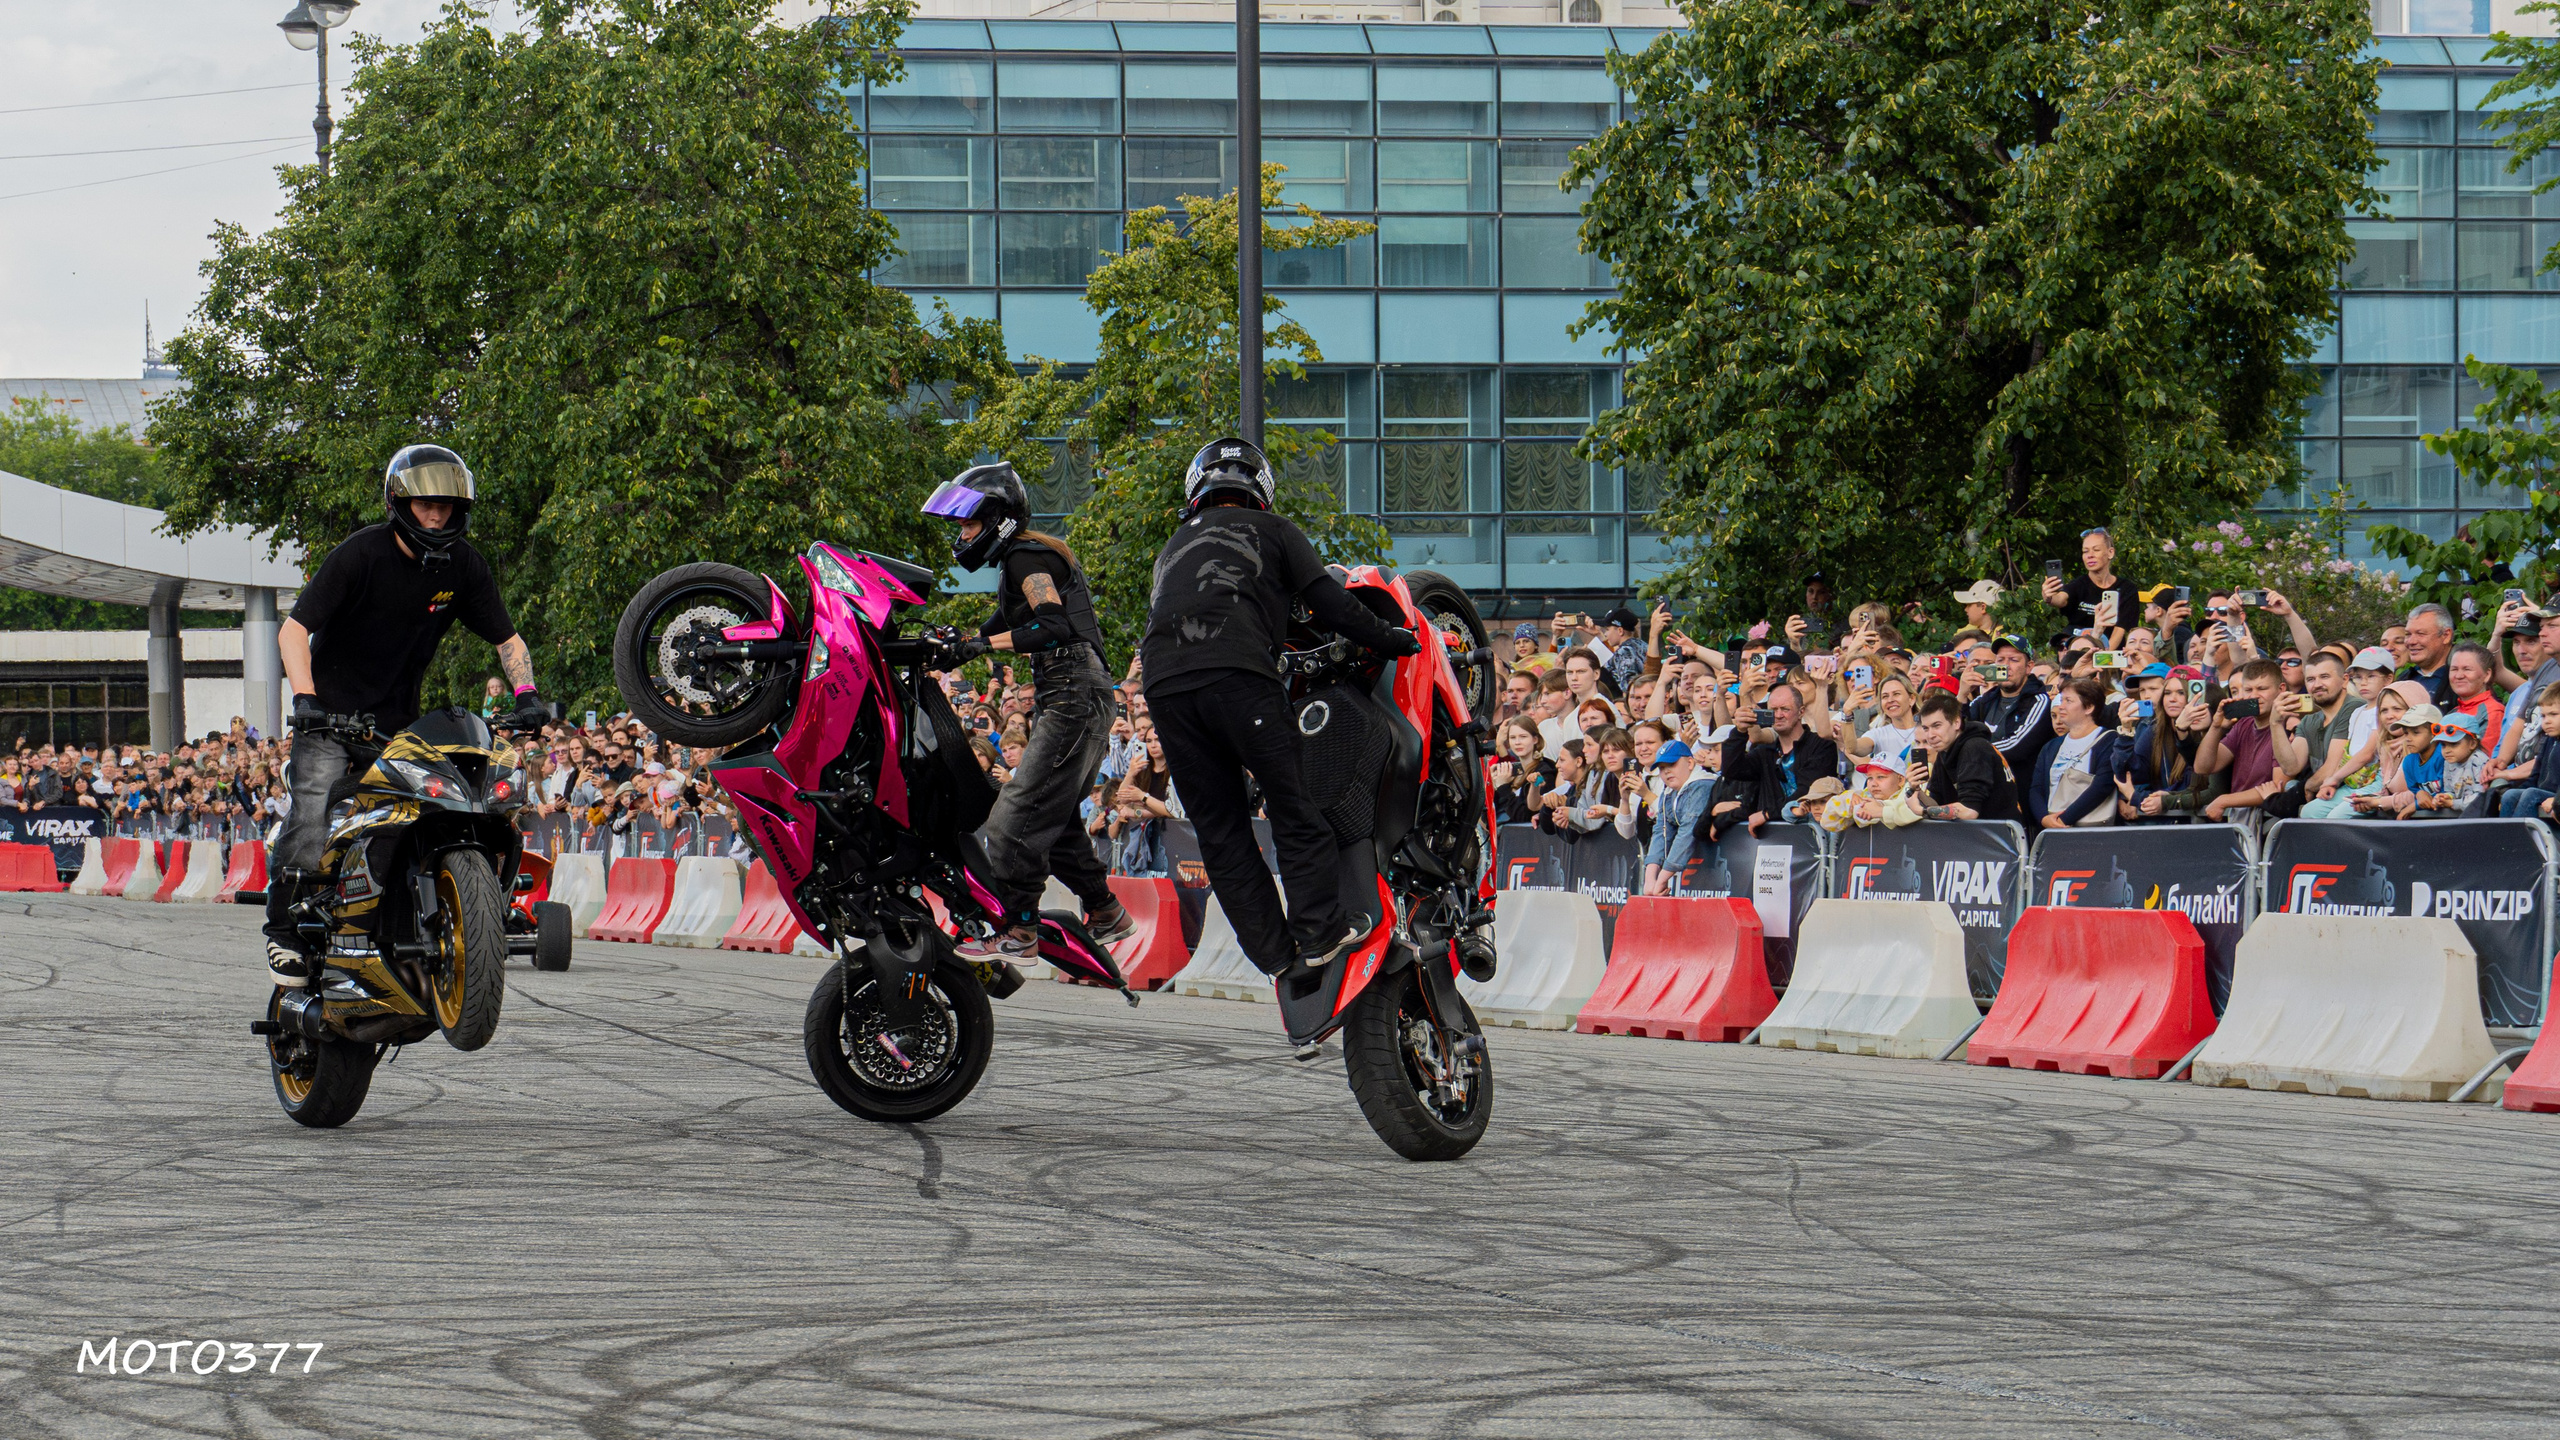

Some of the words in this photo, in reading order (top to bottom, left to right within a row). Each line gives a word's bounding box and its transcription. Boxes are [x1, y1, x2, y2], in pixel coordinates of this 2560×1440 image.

[25, 819, 95, 838] VIRAX
[53, 836, 87, 847] CAPITA
[759, 814, 801, 882] Kawasaki
[1932, 860, 2007, 905] VIRAX
[1958, 909, 2002, 928] CAPITAL
[2167, 883, 2239, 924] билайн
[2435, 890, 2533, 921] PRINZIP
